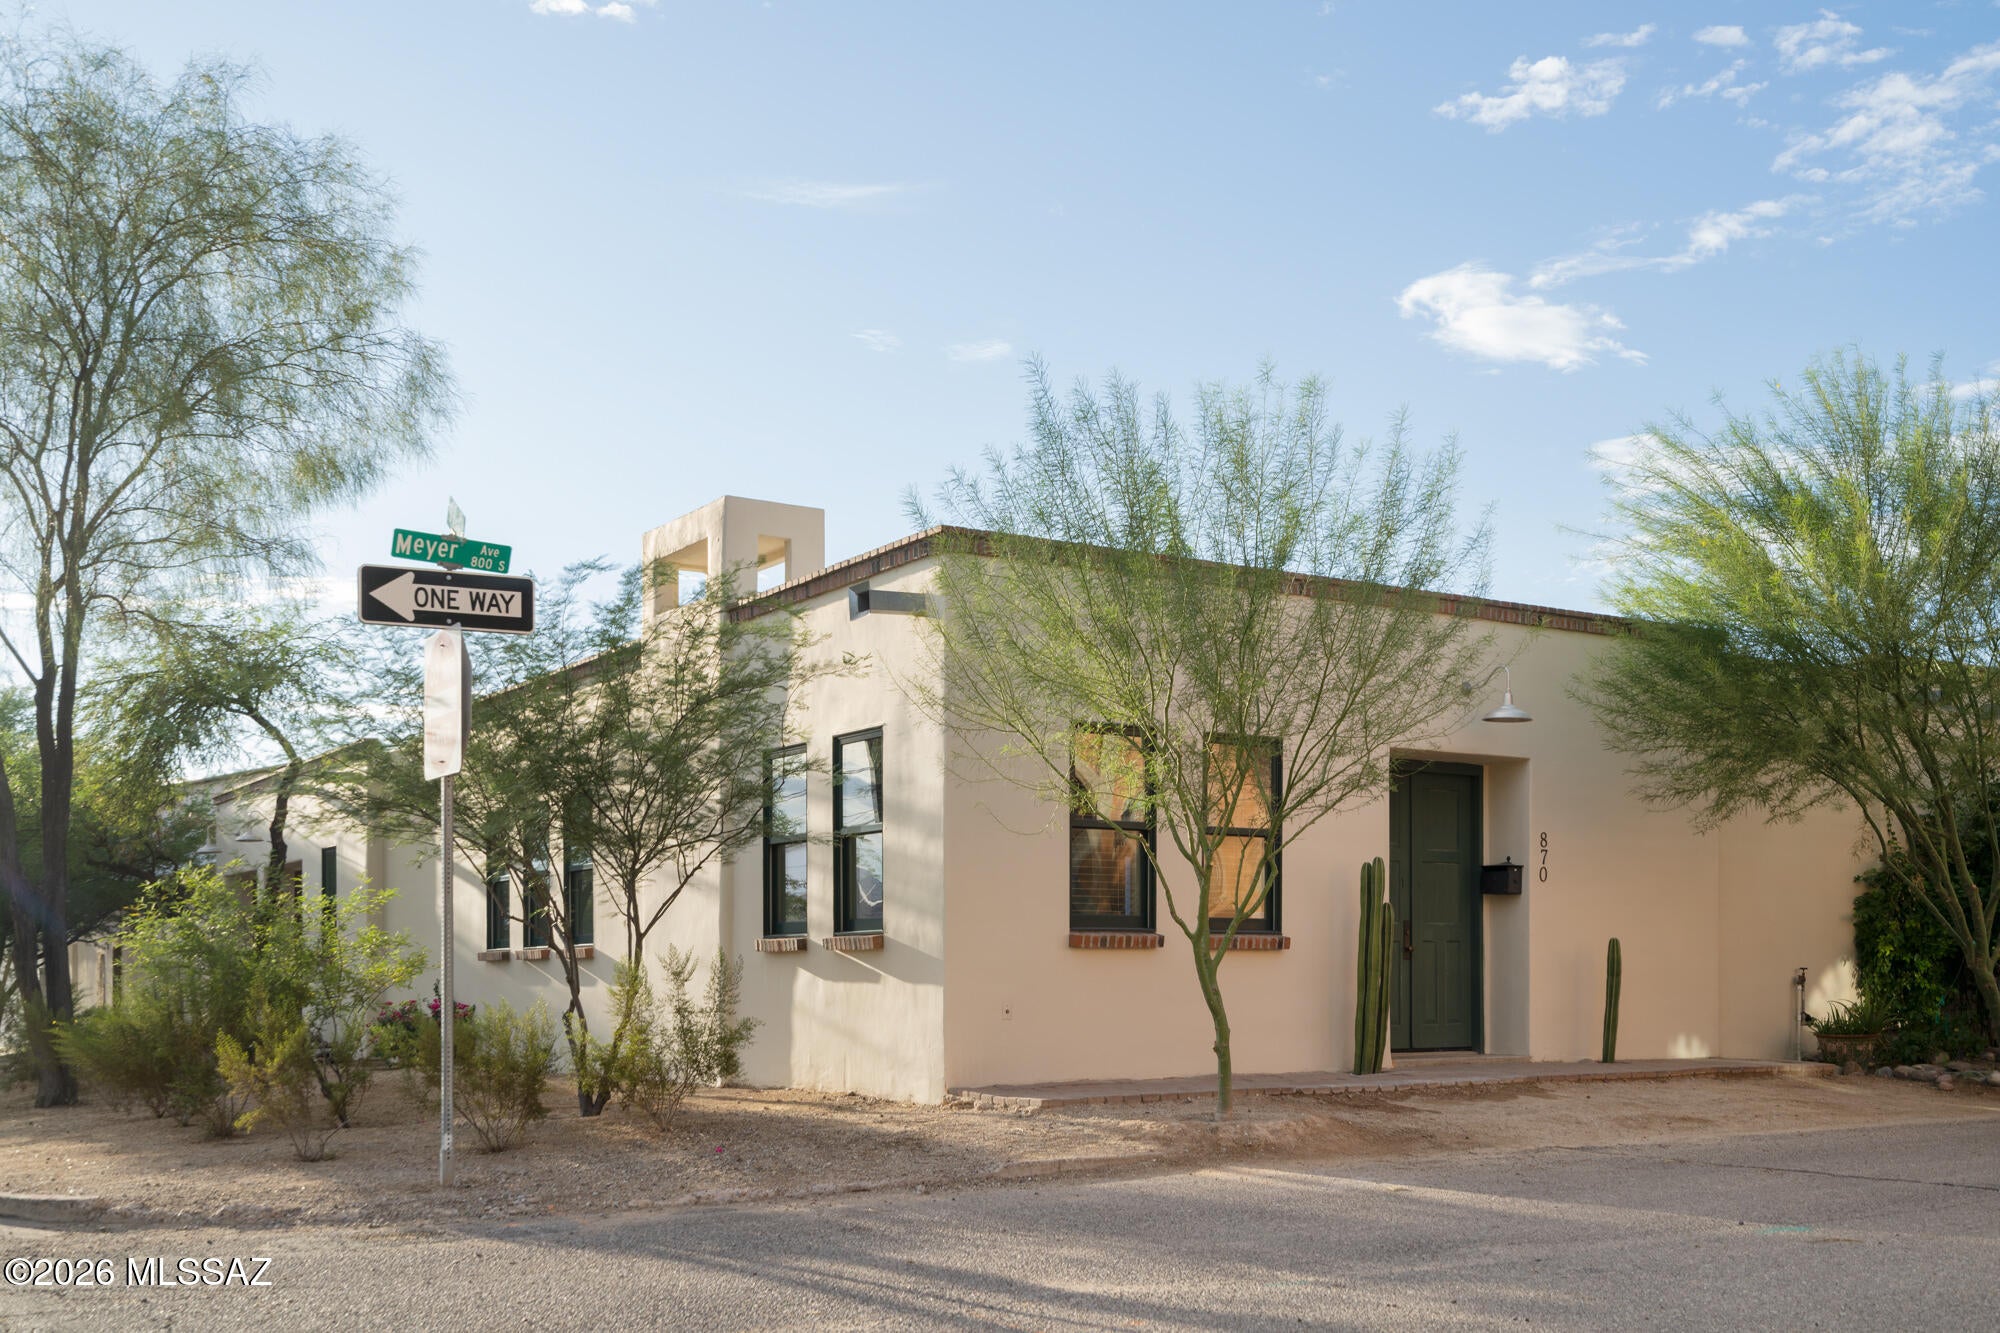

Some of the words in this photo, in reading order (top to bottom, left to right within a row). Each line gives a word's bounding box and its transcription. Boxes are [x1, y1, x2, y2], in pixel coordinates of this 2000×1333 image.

[395, 533, 459, 561] Meyer
[480, 545, 500, 558] Ave
[470, 556, 493, 570] 800
[498, 560, 506, 572] S
[414, 587, 460, 611] ONE
[469, 591, 516, 614] WAY
[1539, 832, 1548, 883] 870
